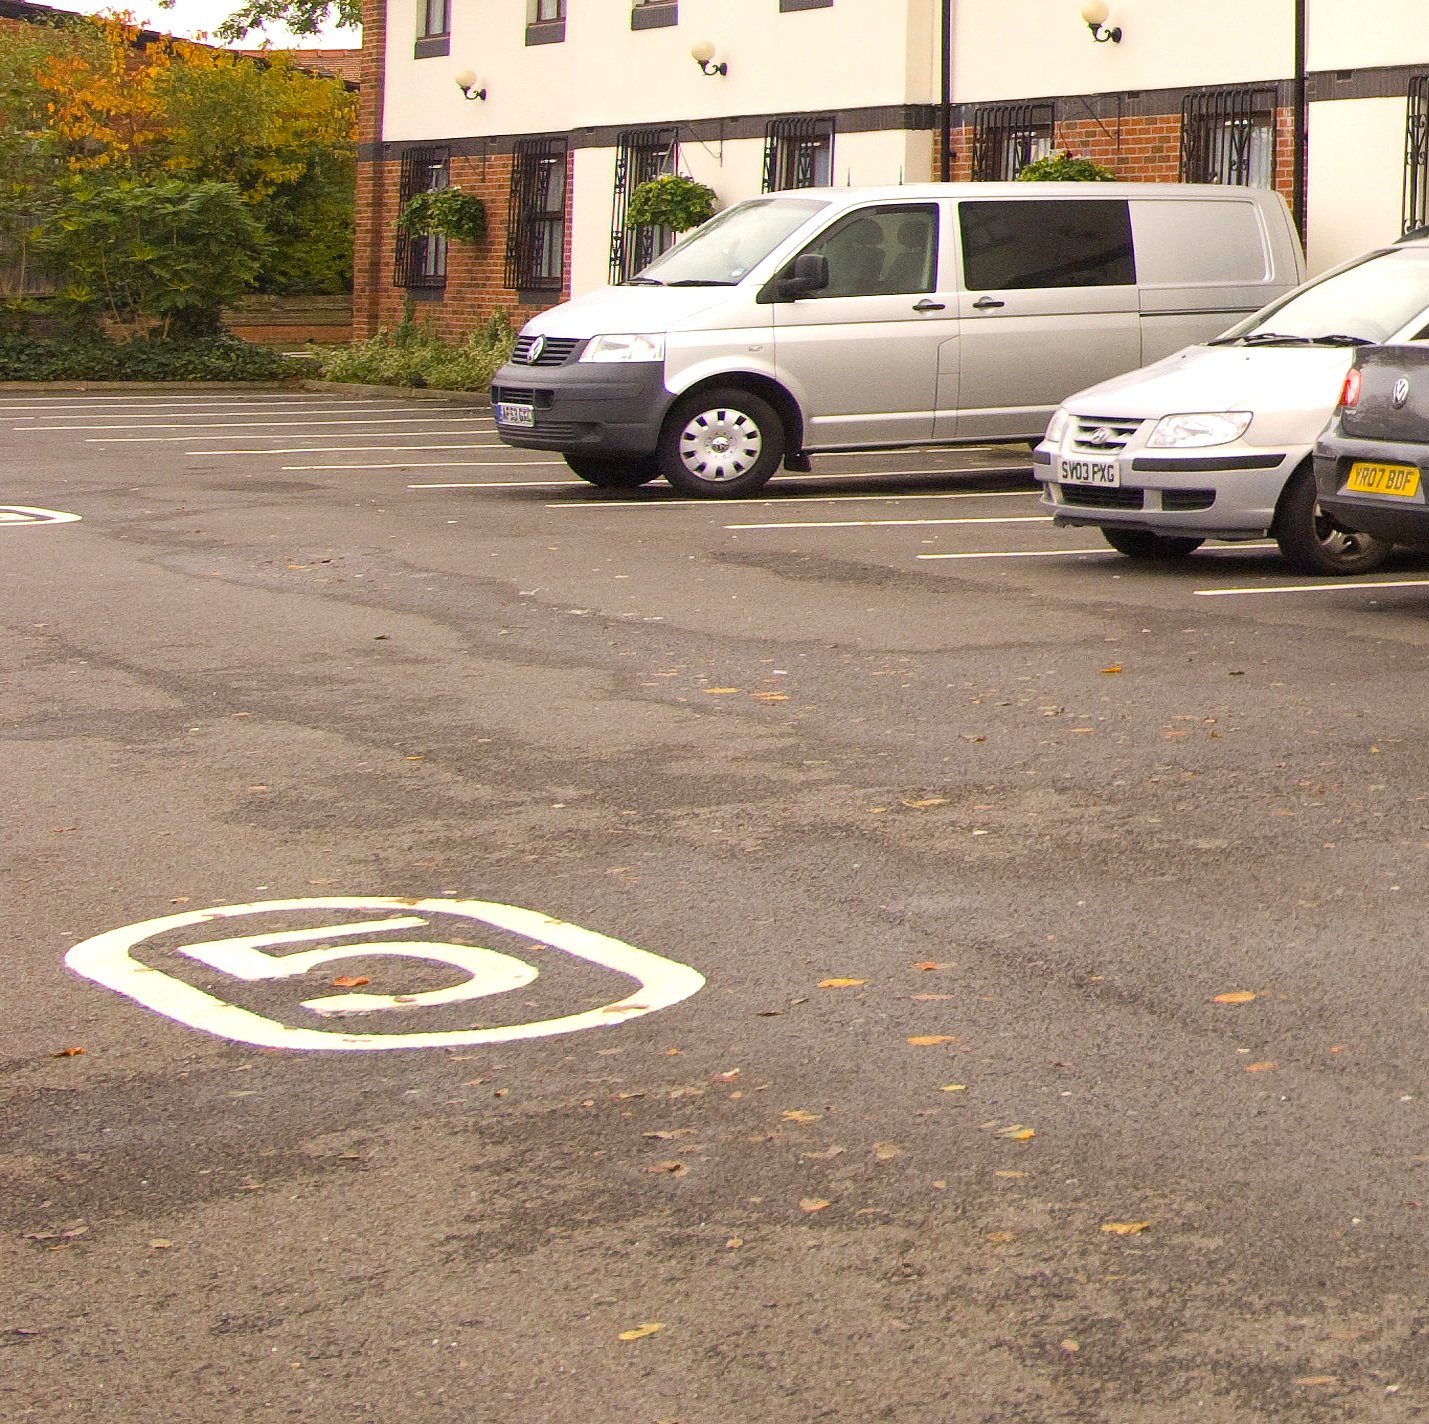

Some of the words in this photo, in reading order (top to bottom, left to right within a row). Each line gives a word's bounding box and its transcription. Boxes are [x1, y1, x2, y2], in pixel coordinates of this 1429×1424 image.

[1061, 461, 1089, 481] SV03
[1091, 463, 1115, 483] PXG
[1354, 467, 1385, 488] YR07
[1385, 469, 1414, 491] BDF
[176, 916, 540, 1017] 5
